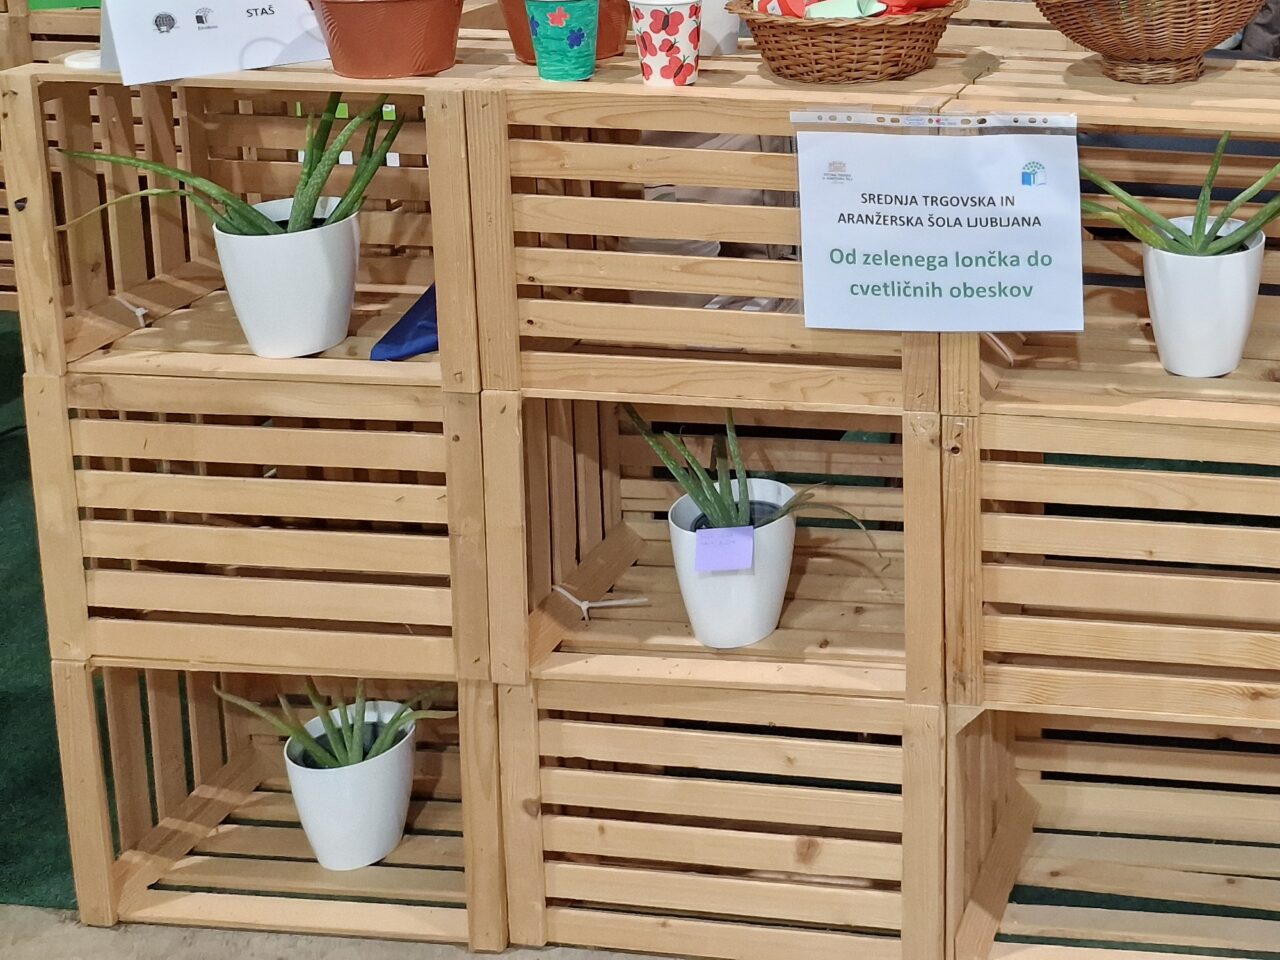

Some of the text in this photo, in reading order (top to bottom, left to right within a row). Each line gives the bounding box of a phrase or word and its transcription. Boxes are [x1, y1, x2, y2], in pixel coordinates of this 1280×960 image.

[246, 4, 276, 18] STAŠ
[860, 192, 1016, 208] SREDNJA TRGOVSKA IN
[837, 211, 1042, 228] ARANŽERSKA ŠOLA LJUBLJANA
[829, 247, 1053, 272] Od zelenega lončka do
[849, 280, 1034, 299] cvetličnih obeskov
